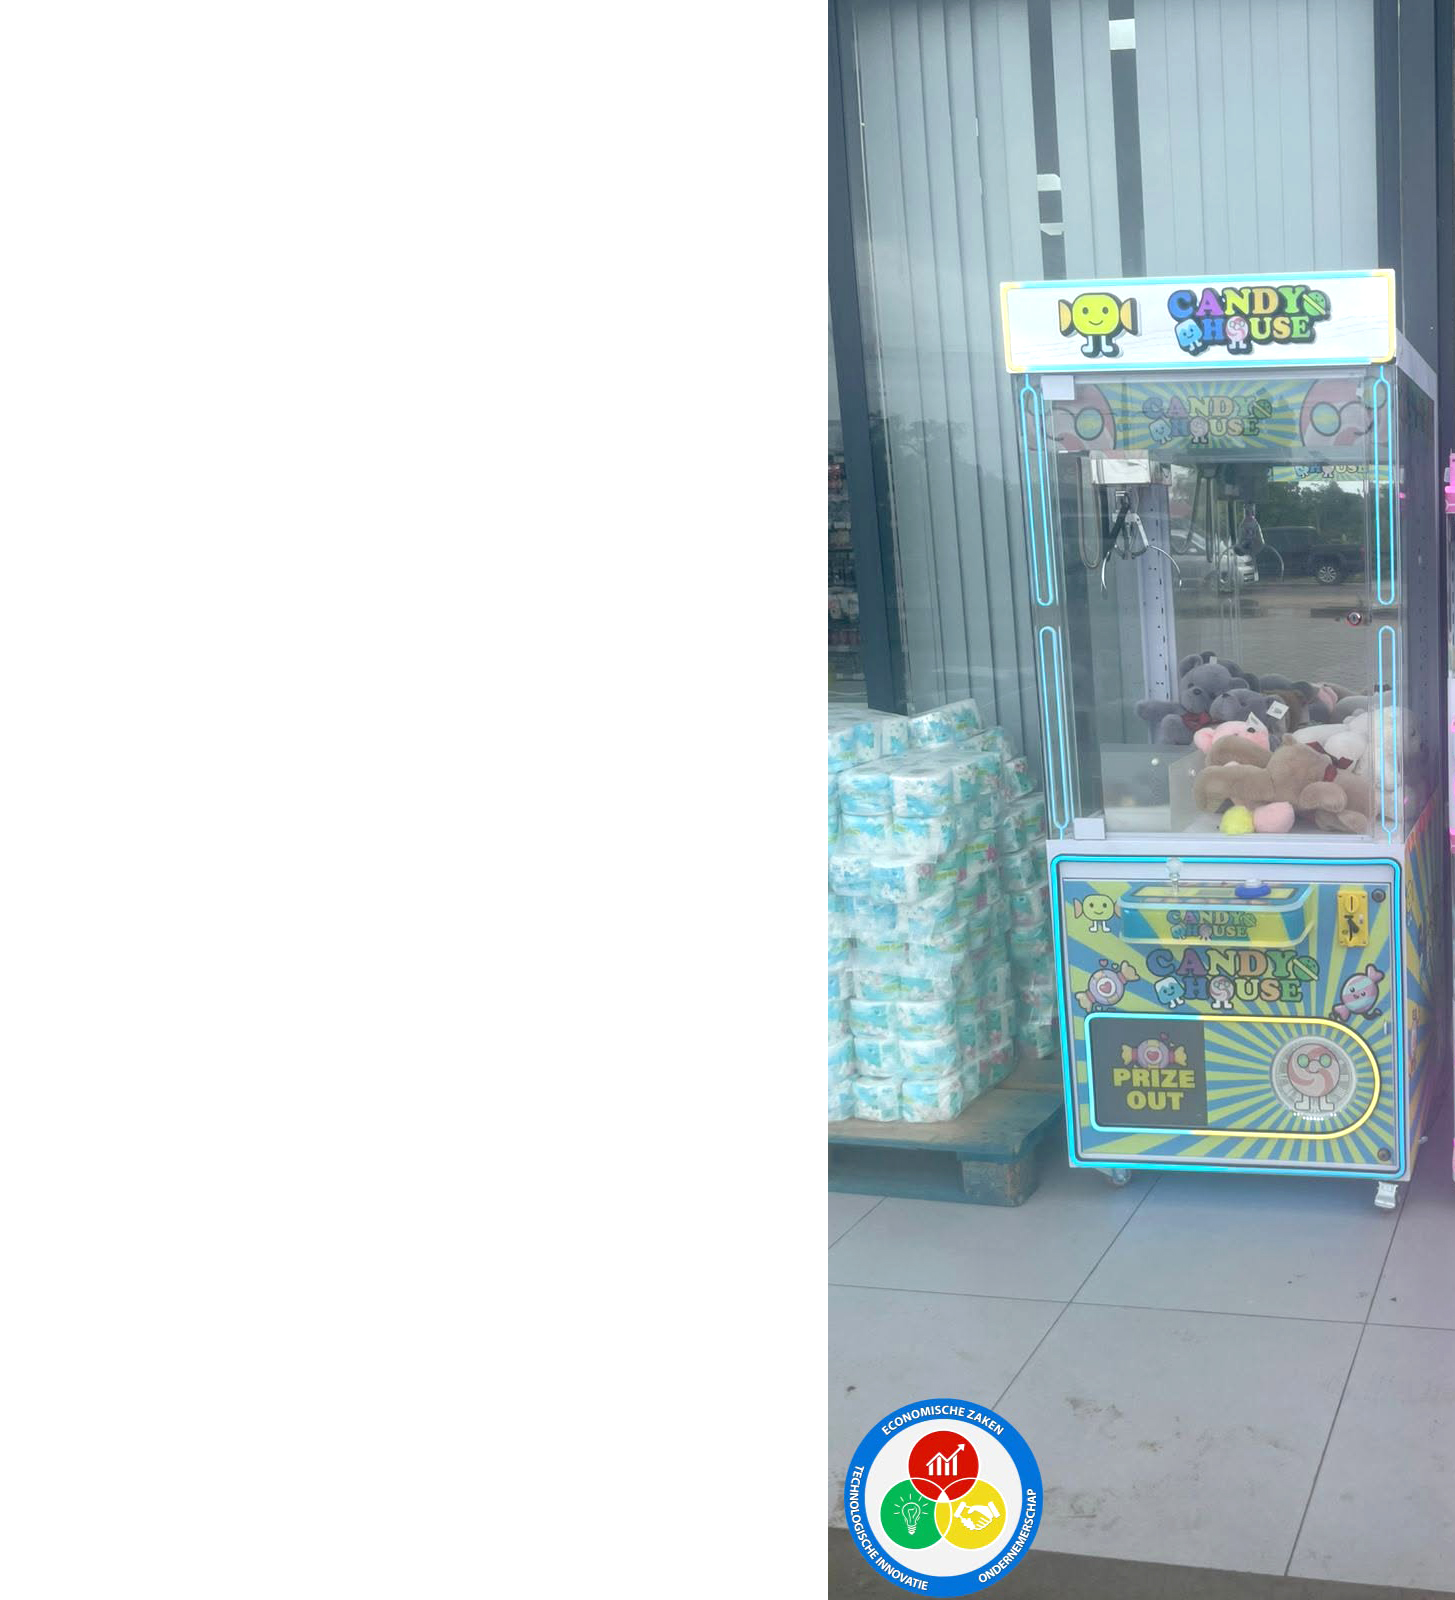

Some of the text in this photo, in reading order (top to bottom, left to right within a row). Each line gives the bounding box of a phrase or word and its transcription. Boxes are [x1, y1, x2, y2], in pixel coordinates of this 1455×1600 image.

[1168, 285, 1307, 320] CANDY
[1143, 396, 1257, 419] CANDY
[1167, 910, 1247, 925] CANDY
[1146, 949, 1298, 978] CANDY
[1113, 1068, 1196, 1090] PRIZE
[1126, 1091, 1185, 1111] OUT
